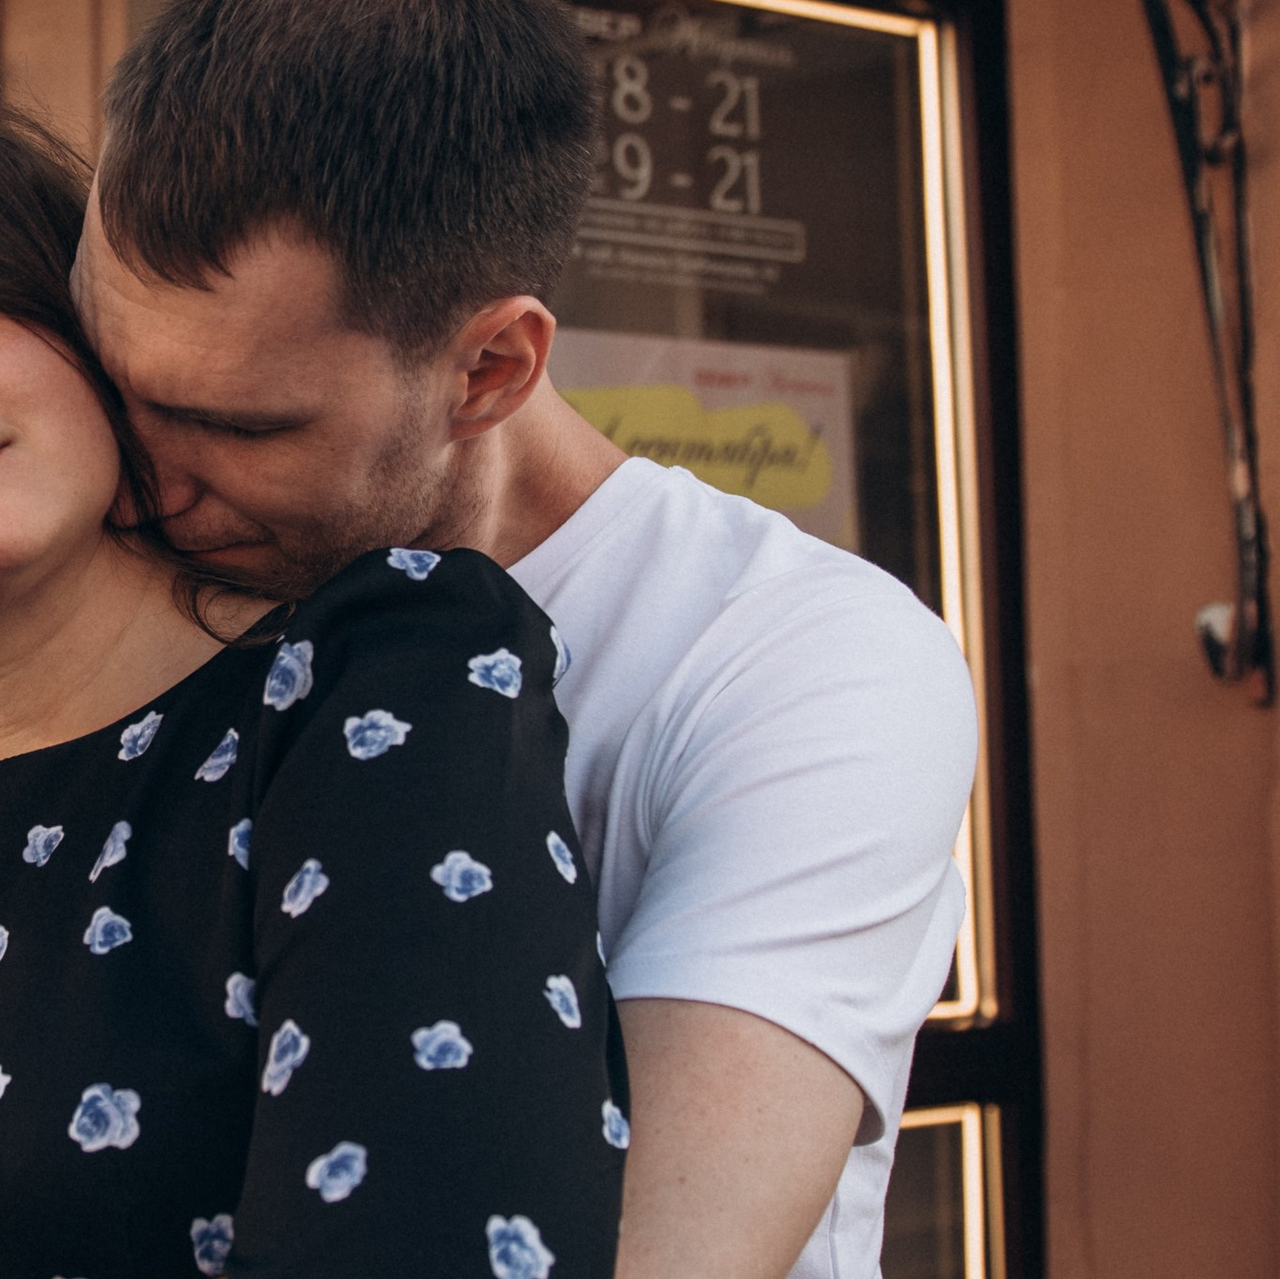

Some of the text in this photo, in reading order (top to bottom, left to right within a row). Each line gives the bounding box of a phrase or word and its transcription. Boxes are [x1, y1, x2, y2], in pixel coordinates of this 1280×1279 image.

[612, 55, 653, 124] 8
[706, 70, 761, 140] 21
[612, 132, 653, 200] 9
[707, 145, 762, 214] 21
